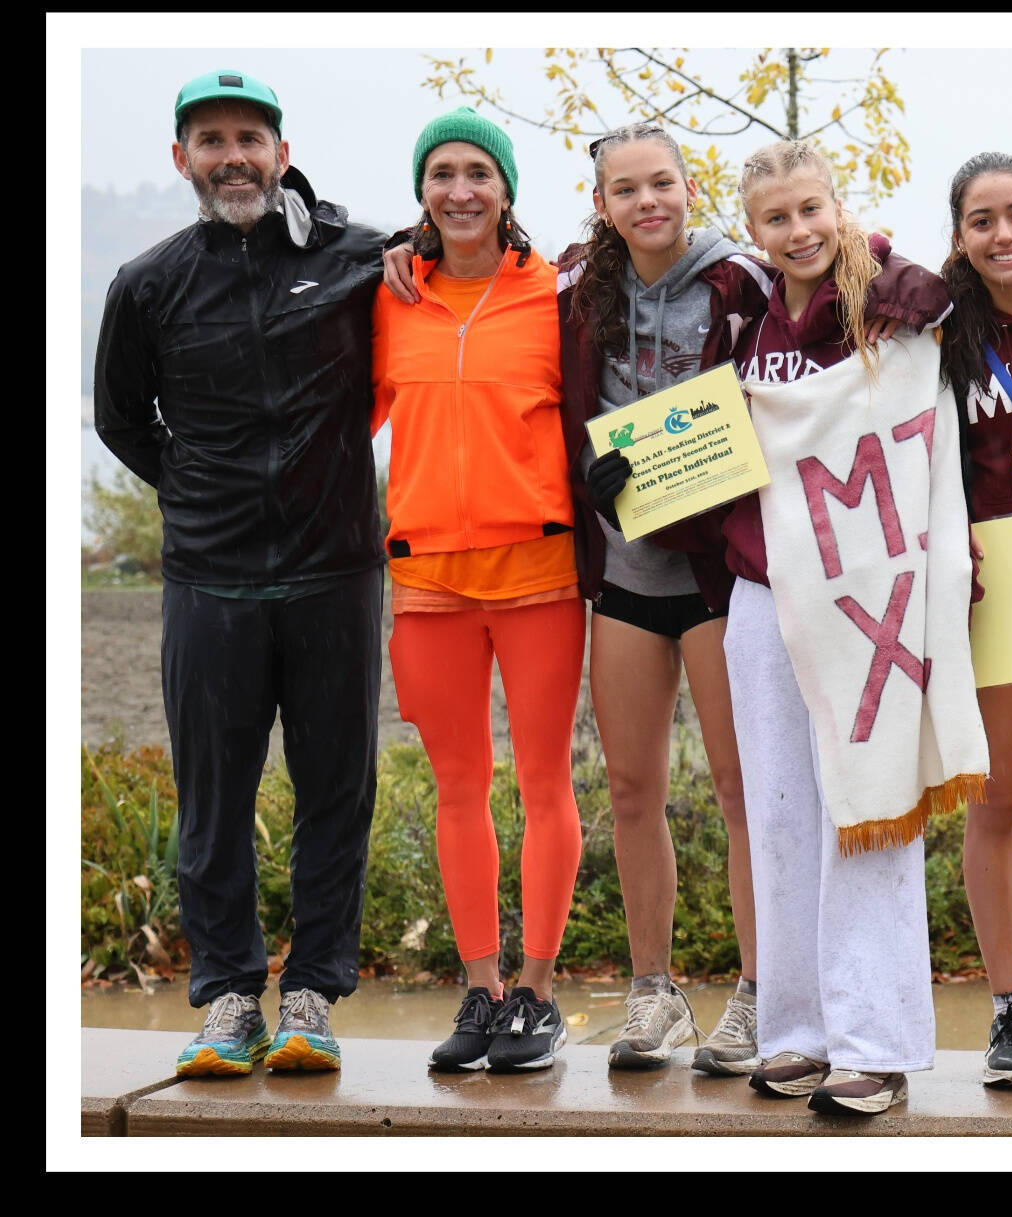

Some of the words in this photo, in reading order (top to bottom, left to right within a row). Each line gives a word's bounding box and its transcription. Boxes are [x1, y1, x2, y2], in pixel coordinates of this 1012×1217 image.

[631, 468, 652, 479] Cross
[652, 455, 682, 471] Country
[682, 444, 708, 459] Second
[708, 436, 729, 449] Team
[641, 455, 652, 464] 3A
[652, 449, 664, 459] All
[667, 437, 697, 453] SeaKing
[696, 425, 726, 441] District
[635, 478, 658, 493] 12th
[657, 468, 683, 483] Place
[683, 446, 734, 473] Individual
